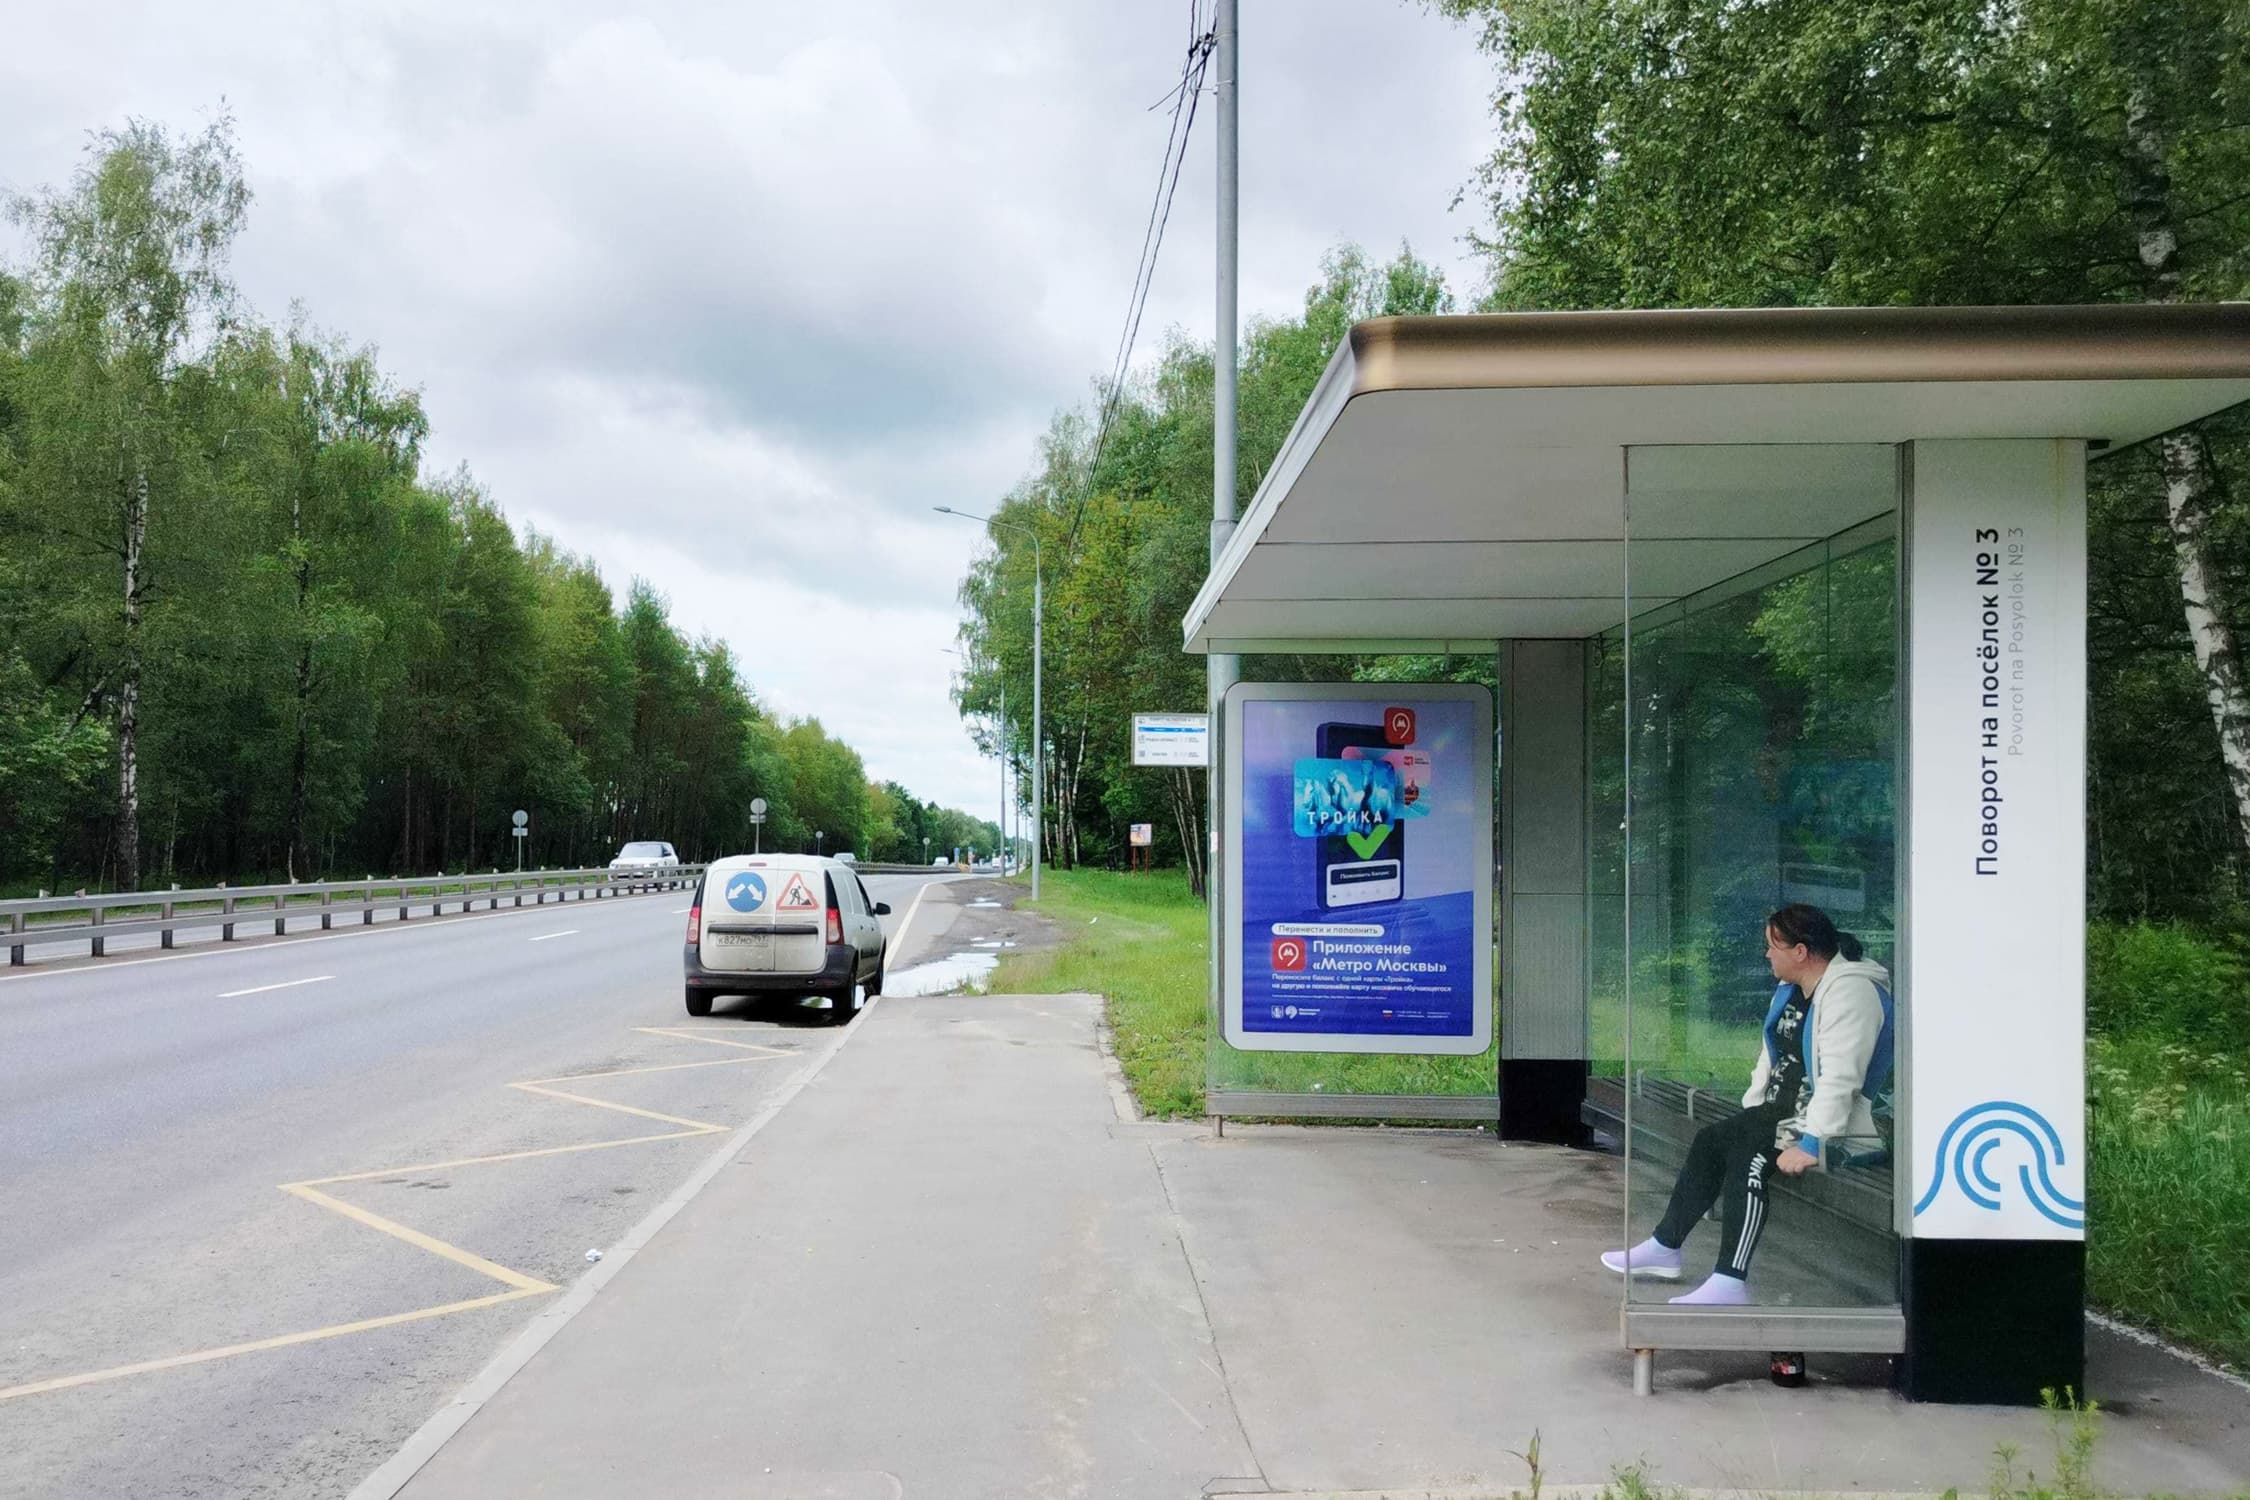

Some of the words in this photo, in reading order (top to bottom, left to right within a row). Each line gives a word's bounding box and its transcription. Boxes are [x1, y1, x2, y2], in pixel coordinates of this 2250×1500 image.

[1976, 528, 1999, 545] 3
[2007, 527, 2025, 538] 3
[2007, 572, 2028, 653] Posyolok
[1977, 595, 2000, 709] посёлок
[2011, 659, 2025, 681] na
[2007, 685, 2025, 757] Povorot
[1981, 717, 1999, 749] на
[1306, 808, 1384, 826] ТРОЙКА
[1975, 755, 2003, 877] Поворот
[1278, 925, 1325, 935] Перенести
[1333, 927, 1379, 935] пополнить
[1312, 940, 1412, 956] Приложение
[1312, 957, 1373, 974] «Метро
[1375, 958, 1447, 973] Москвы»
[1747, 1152, 1768, 1190] NIKE
